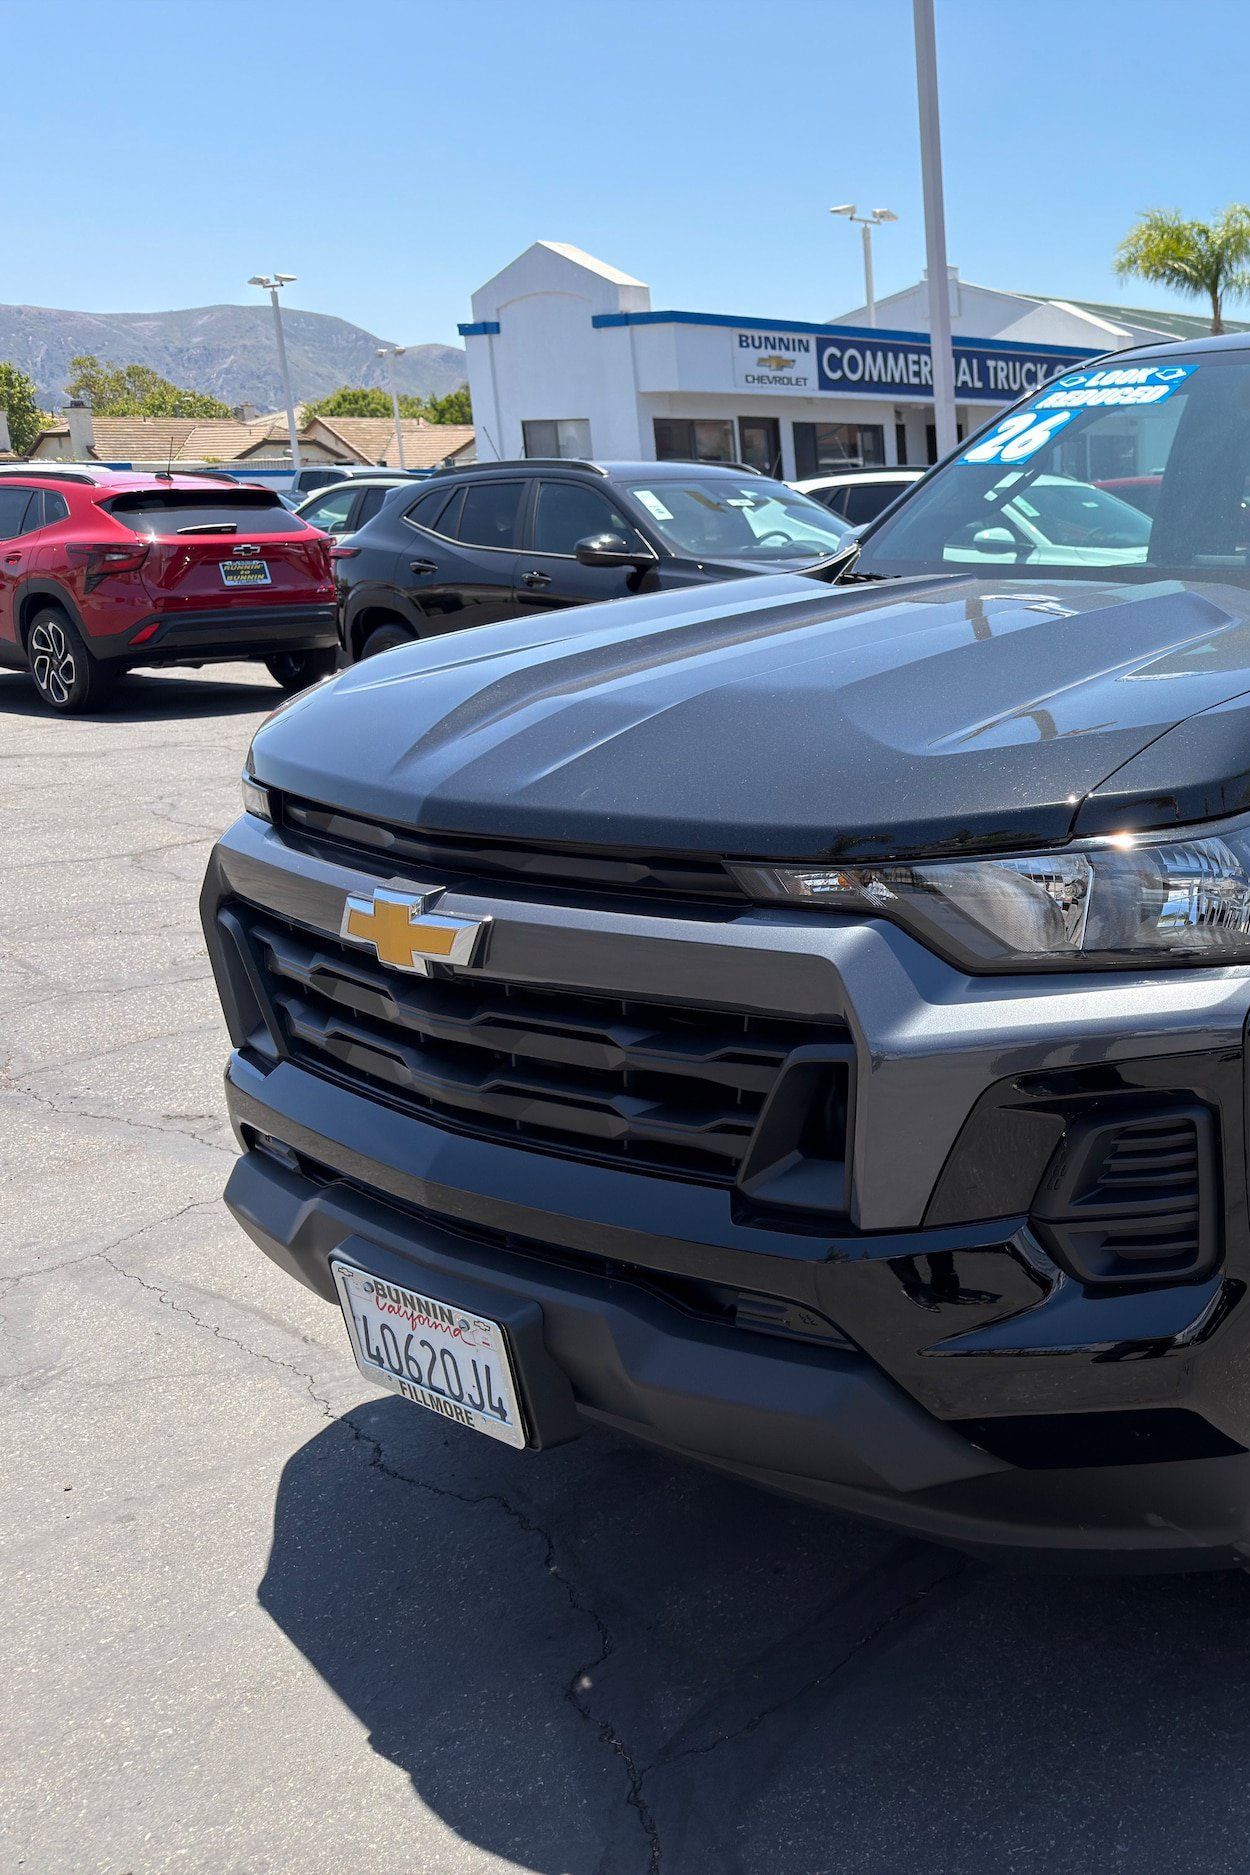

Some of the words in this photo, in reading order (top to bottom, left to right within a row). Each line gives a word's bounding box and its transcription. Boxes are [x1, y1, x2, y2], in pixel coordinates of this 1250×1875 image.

[738, 334, 810, 353] BUNNIN
[745, 374, 809, 387] CHEVROLET
[822, 346, 983, 389] COMMERIAL
[986, 360, 1048, 391] TRUCK
[1085, 367, 1159, 387] LOOK
[1035, 385, 1170, 409] REDUCED
[963, 411, 1072, 463] 26
[373, 1279, 455, 1327] BUNNIN
[362, 1314, 508, 1424] 40620J4
[399, 1380, 476, 1428] FILLMORE
